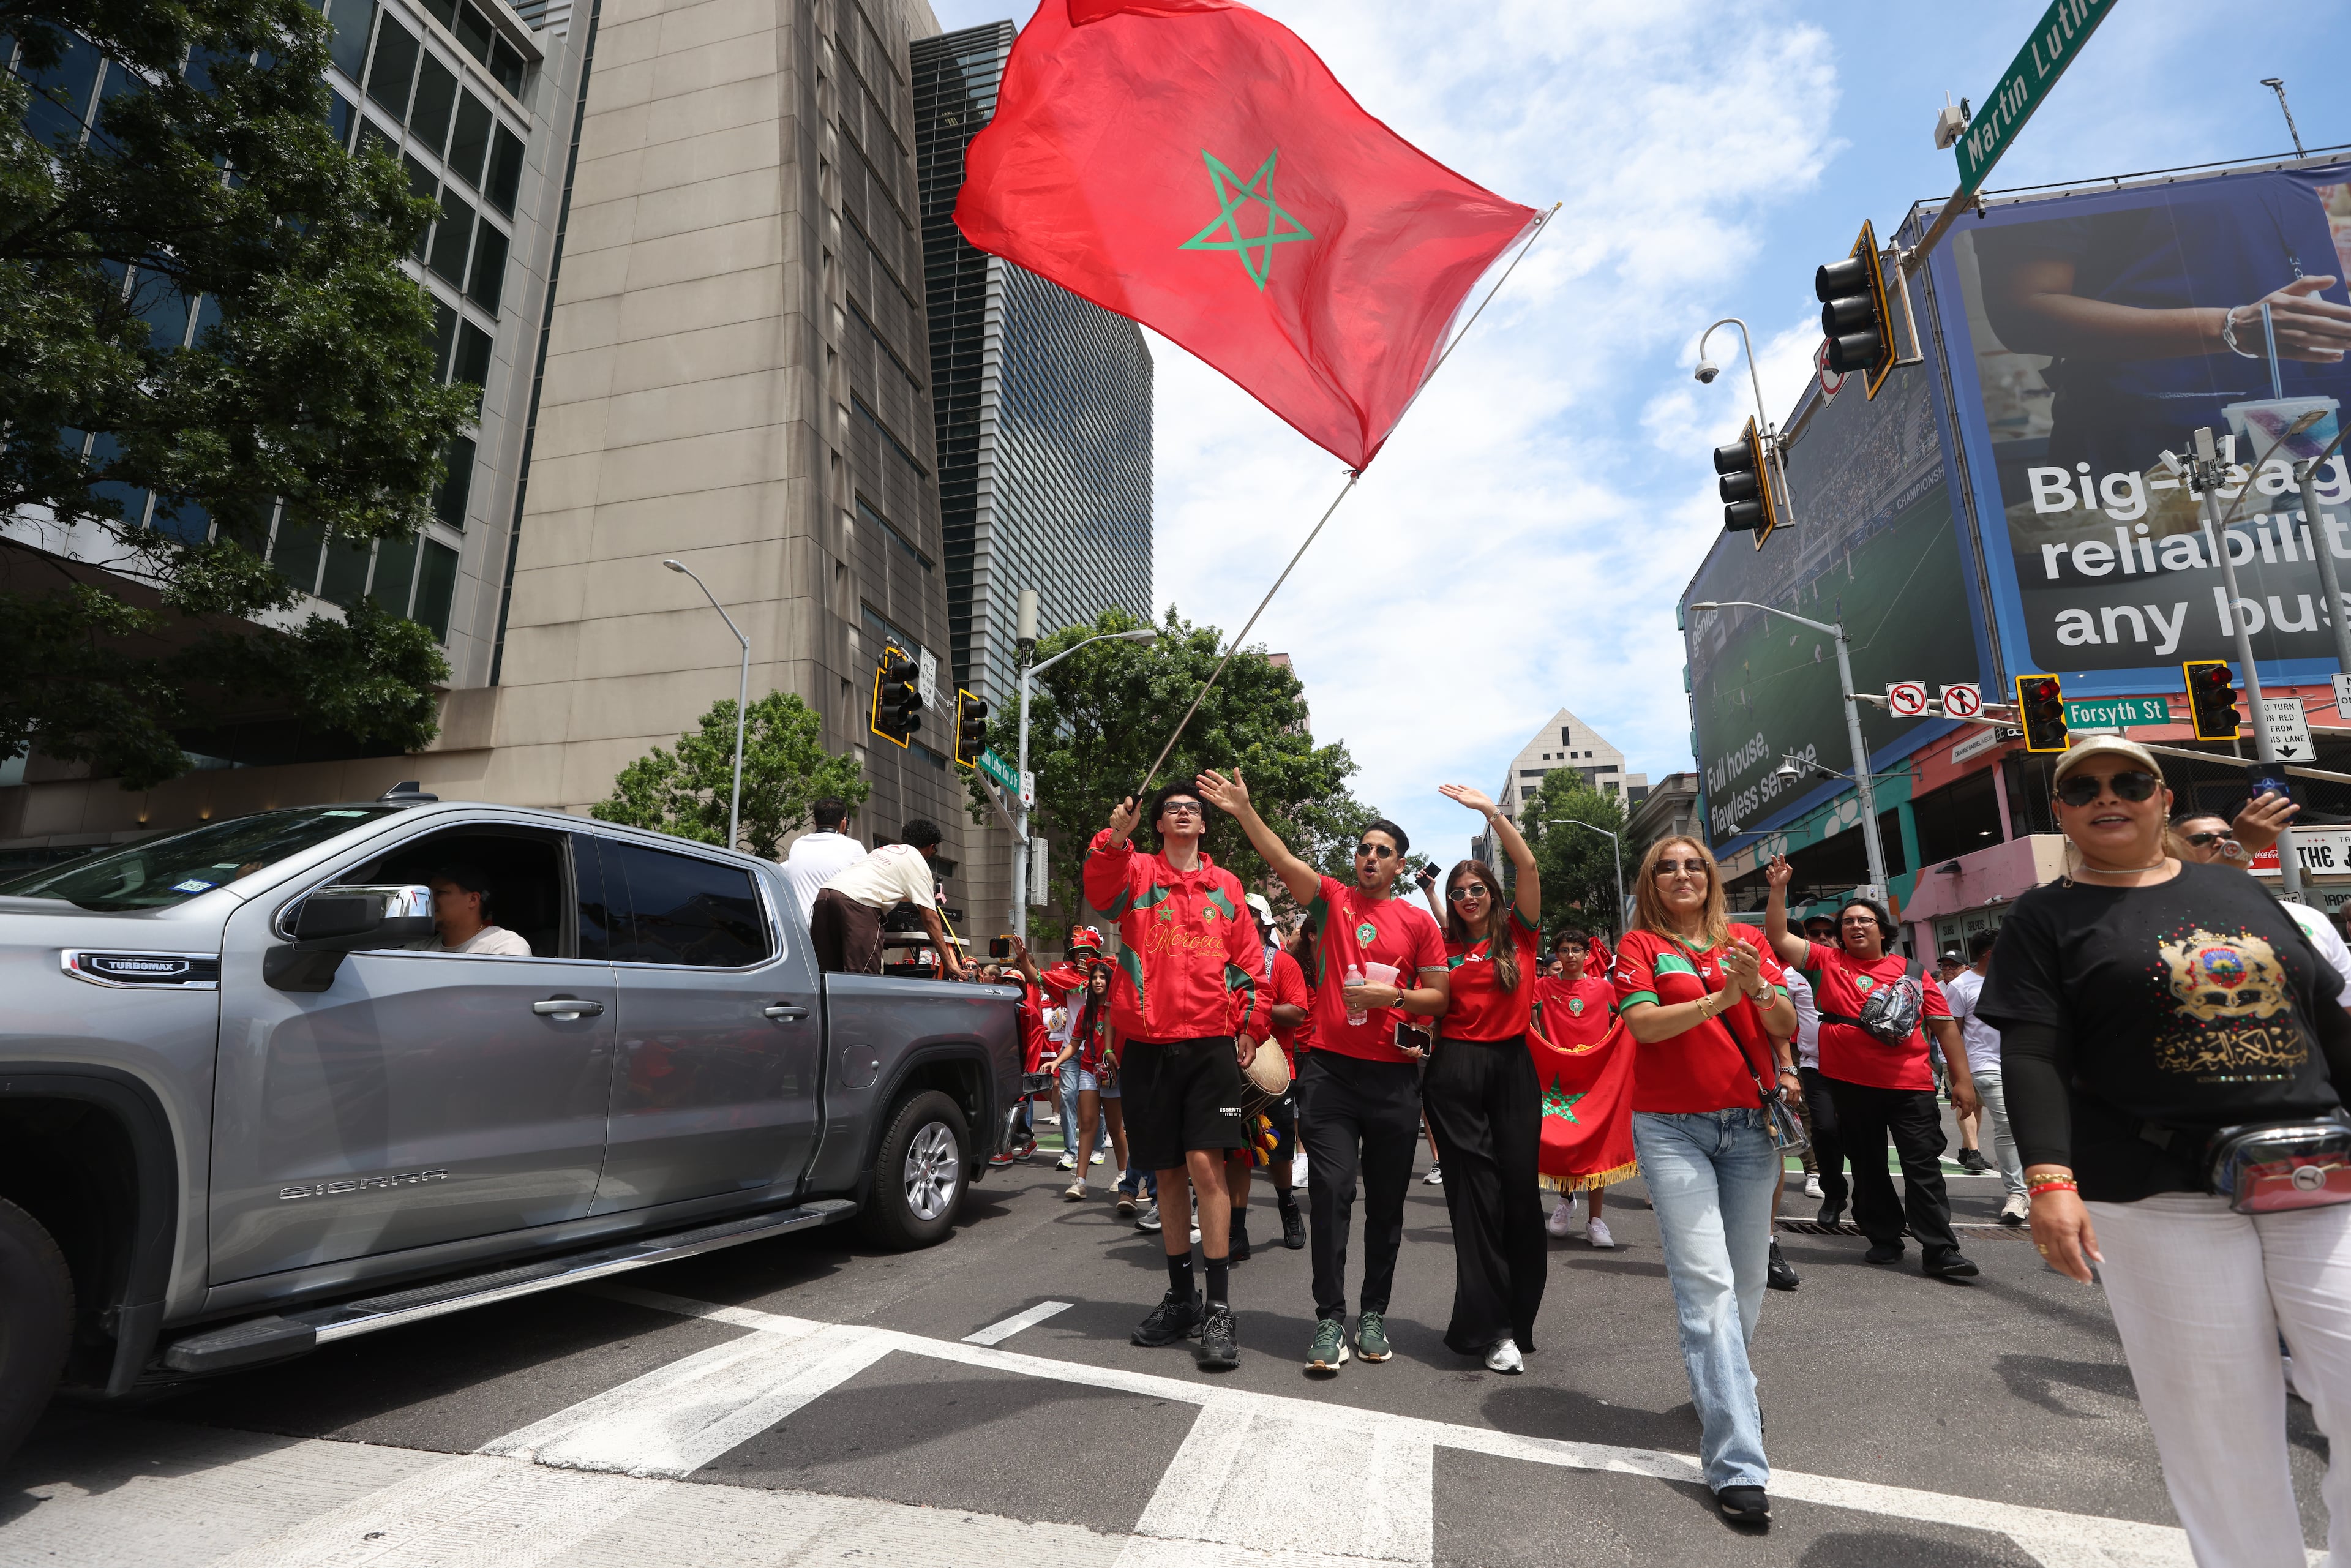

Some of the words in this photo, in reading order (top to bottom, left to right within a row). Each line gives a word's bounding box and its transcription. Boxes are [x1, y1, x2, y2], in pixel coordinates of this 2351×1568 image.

[1967, 75, 2028, 173] Martin
[2055, 602, 2189, 655] any
[923, 661, 933, 677] YIELD
[2071, 702, 2137, 725] Forsyth
[2144, 700, 2162, 720] St
[2273, 703, 2295, 711] TURN
[1955, 745, 1968, 757] ORANGE
[991, 754, 1002, 776] Luther
[1013, 773, 1018, 789] Dr
[1707, 757, 1726, 797] Full
[1727, 732, 1769, 782] house,
[1024, 772, 1031, 781] NO
[1711, 785, 1758, 836] flawless
[2255, 849, 2279, 859] Coca-Col
[2296, 846, 2334, 868] THE
[1943, 925, 1954, 936] SUBS
[1967, 919, 1985, 932] SALADS
[108, 961, 174, 971] TURBOMAX
[279, 1169, 448, 1199] SIERRA
